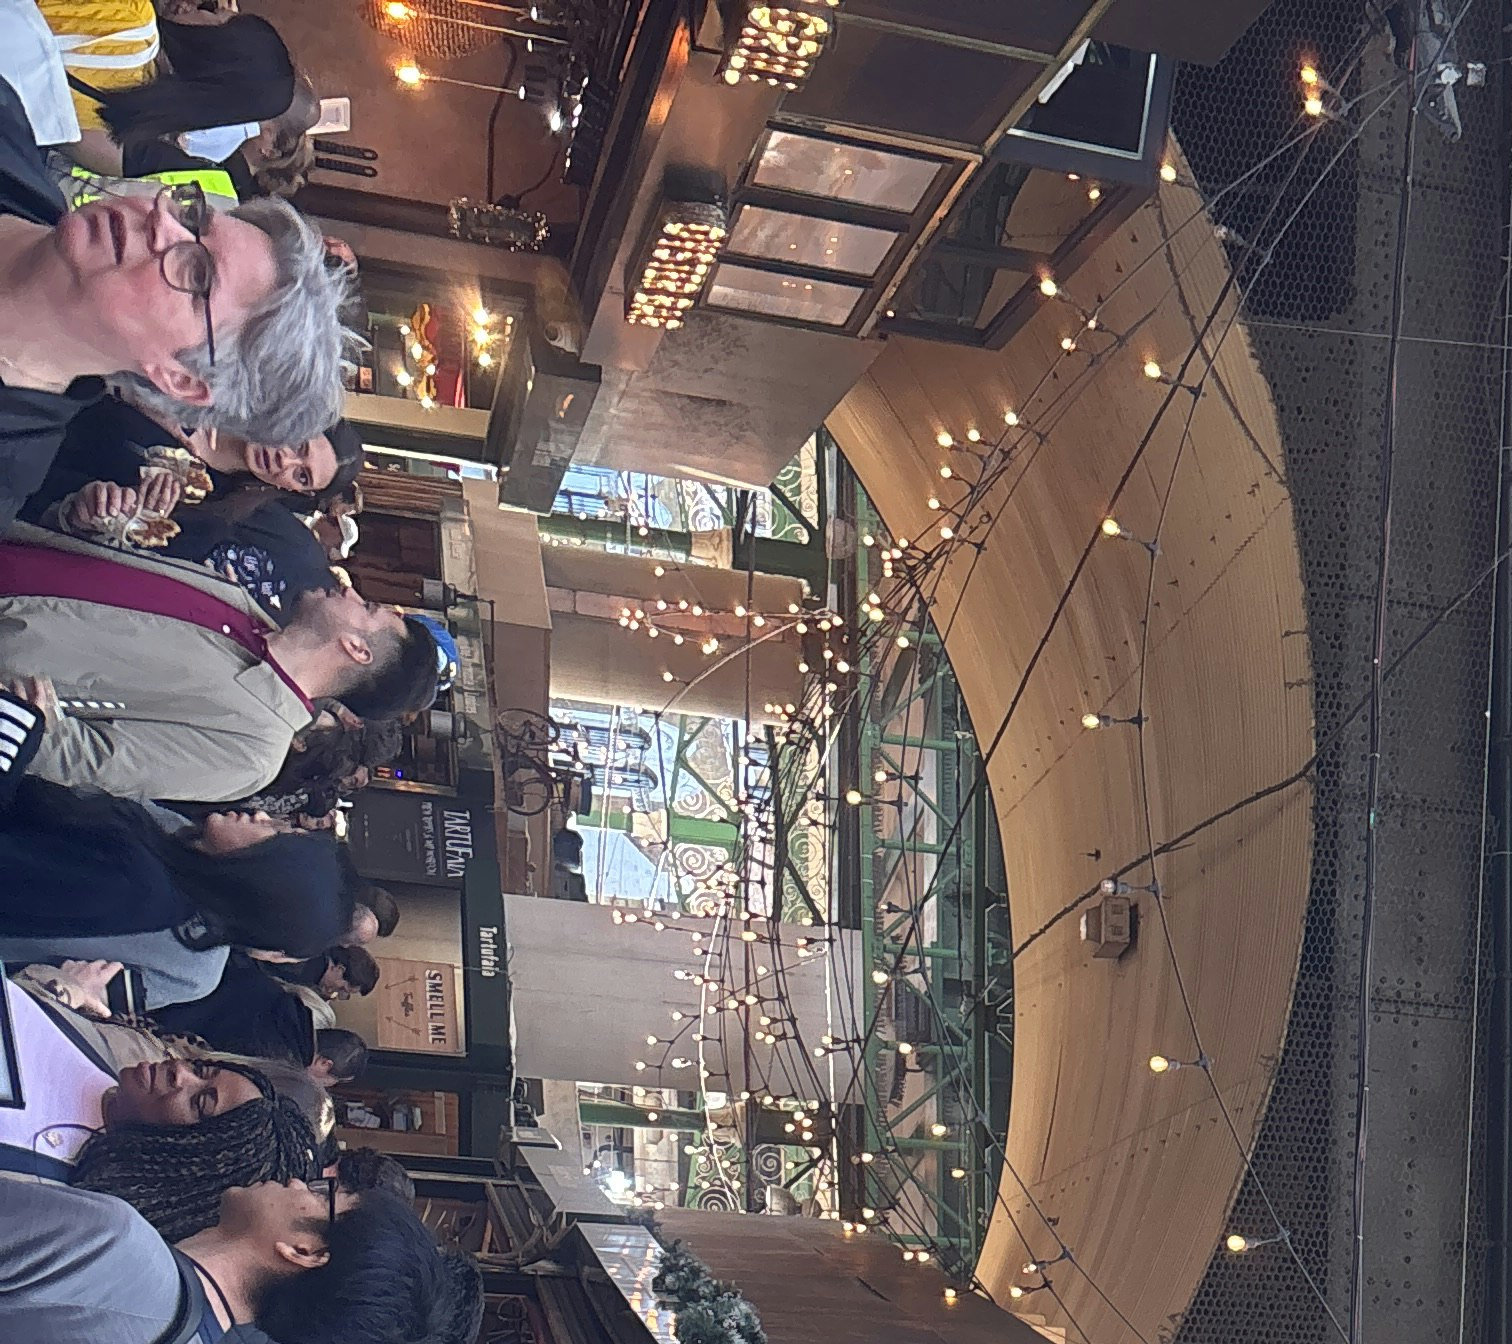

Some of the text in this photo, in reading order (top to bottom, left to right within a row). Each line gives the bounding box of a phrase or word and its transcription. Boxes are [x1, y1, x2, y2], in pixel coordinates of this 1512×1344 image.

[479, 926, 499, 978] Tartufaia
[425, 970, 447, 1046] SMELL ME
